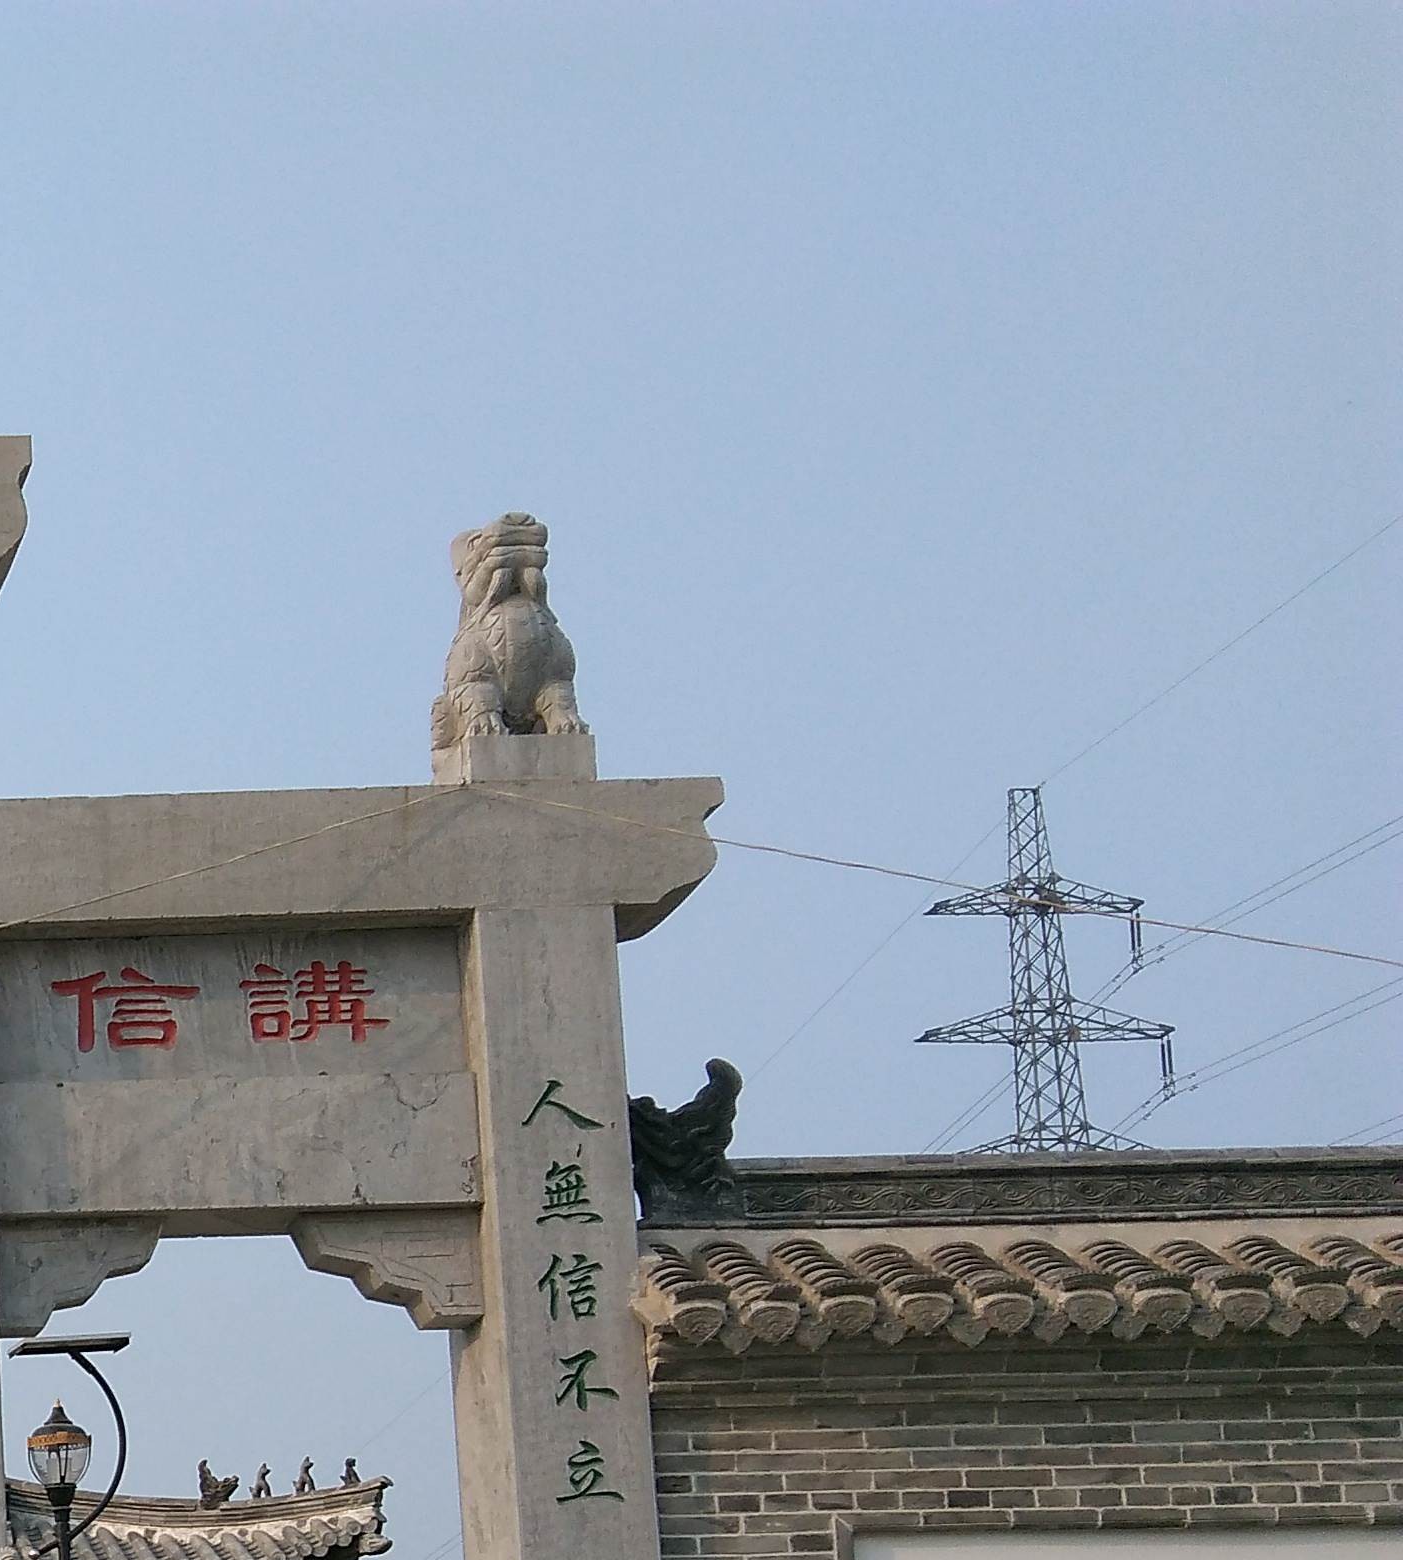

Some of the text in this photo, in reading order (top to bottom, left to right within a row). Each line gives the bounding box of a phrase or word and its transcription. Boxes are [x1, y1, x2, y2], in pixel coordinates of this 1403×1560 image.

[51, 960, 390, 1053] 講信
[521, 1079, 624, 1503] 人無信不立
